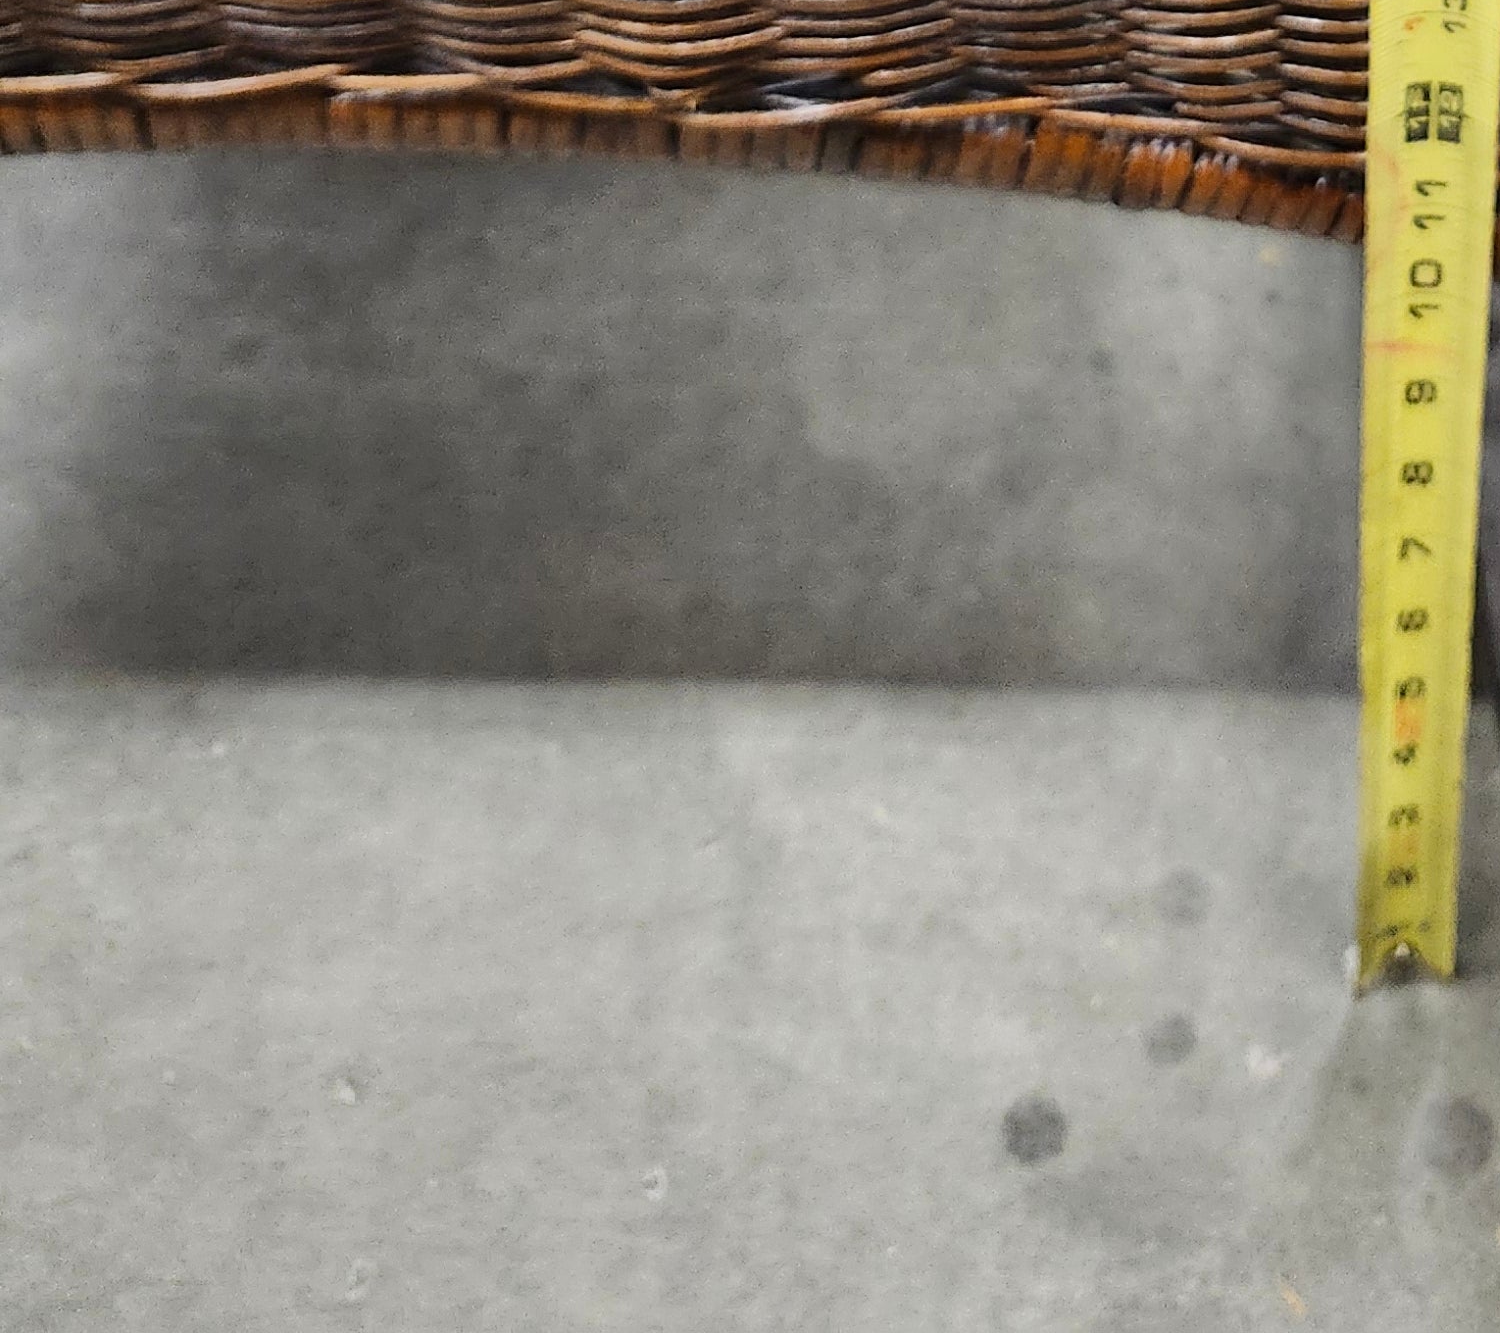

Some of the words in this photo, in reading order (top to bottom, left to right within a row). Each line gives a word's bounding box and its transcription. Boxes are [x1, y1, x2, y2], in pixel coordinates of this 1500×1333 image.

[1412, 179, 1449, 230] 11
[1408, 257, 1443, 320] 10
[1404, 379, 1438, 405] 9
[1401, 460, 1434, 486] 8
[1397, 536, 1432, 561] 7
